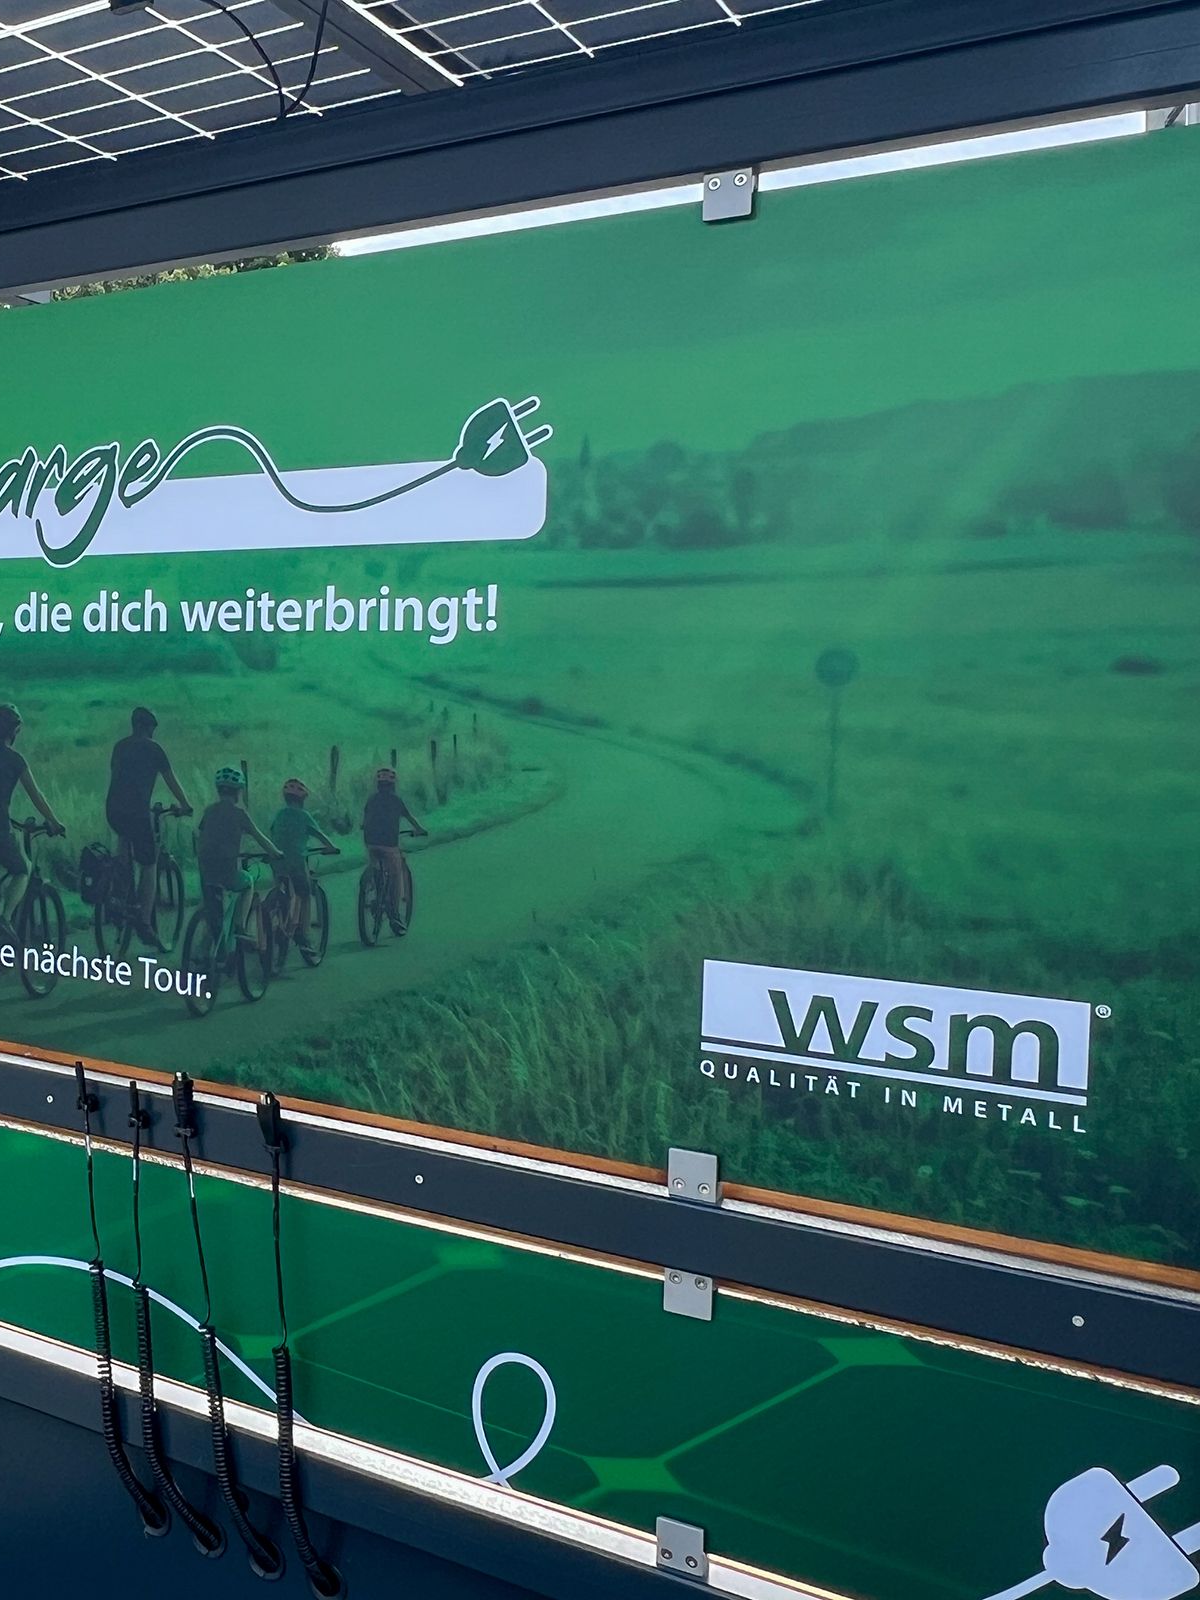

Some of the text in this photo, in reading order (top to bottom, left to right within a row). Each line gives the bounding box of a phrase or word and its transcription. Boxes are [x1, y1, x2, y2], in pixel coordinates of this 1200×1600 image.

[13, 591, 73, 634] die
[76, 589, 168, 634] dich
[180, 583, 499, 646] weiterbringt!
[22, 943, 132, 987] nächste
[137, 955, 213, 1000] Tour.
[767, 988, 1061, 1089] wsm
[699, 1058, 1088, 1135] QUALITÄT IN METALL
